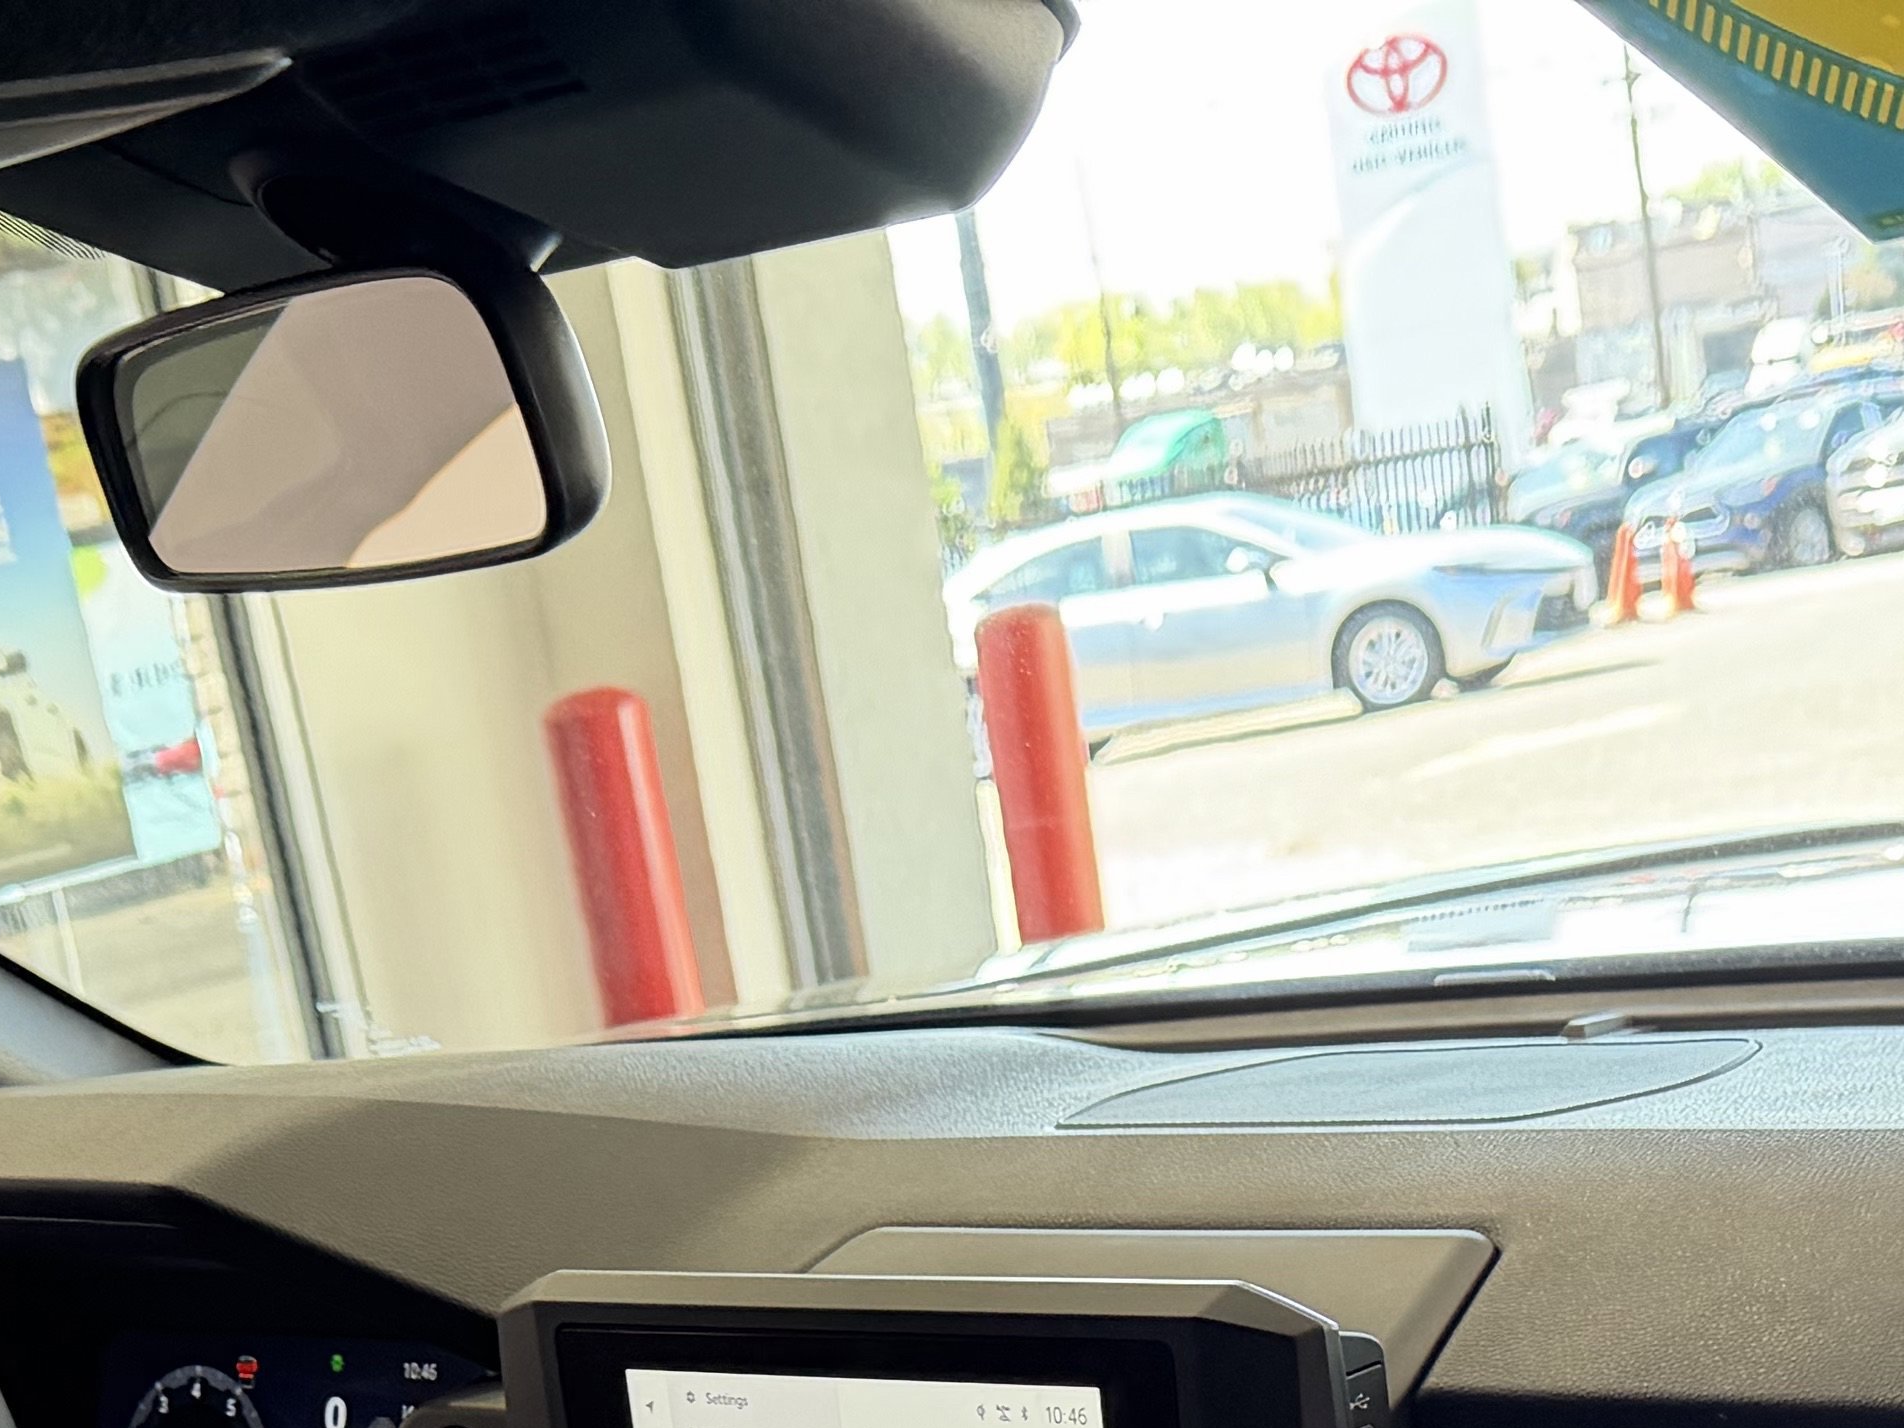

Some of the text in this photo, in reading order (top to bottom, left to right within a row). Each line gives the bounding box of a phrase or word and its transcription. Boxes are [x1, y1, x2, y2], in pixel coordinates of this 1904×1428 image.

[157, 1396, 169, 1414] 3
[225, 1398, 237, 1417] 5
[705, 1392, 749, 1410] Settings
[1045, 1405, 1088, 1426] 10:46
